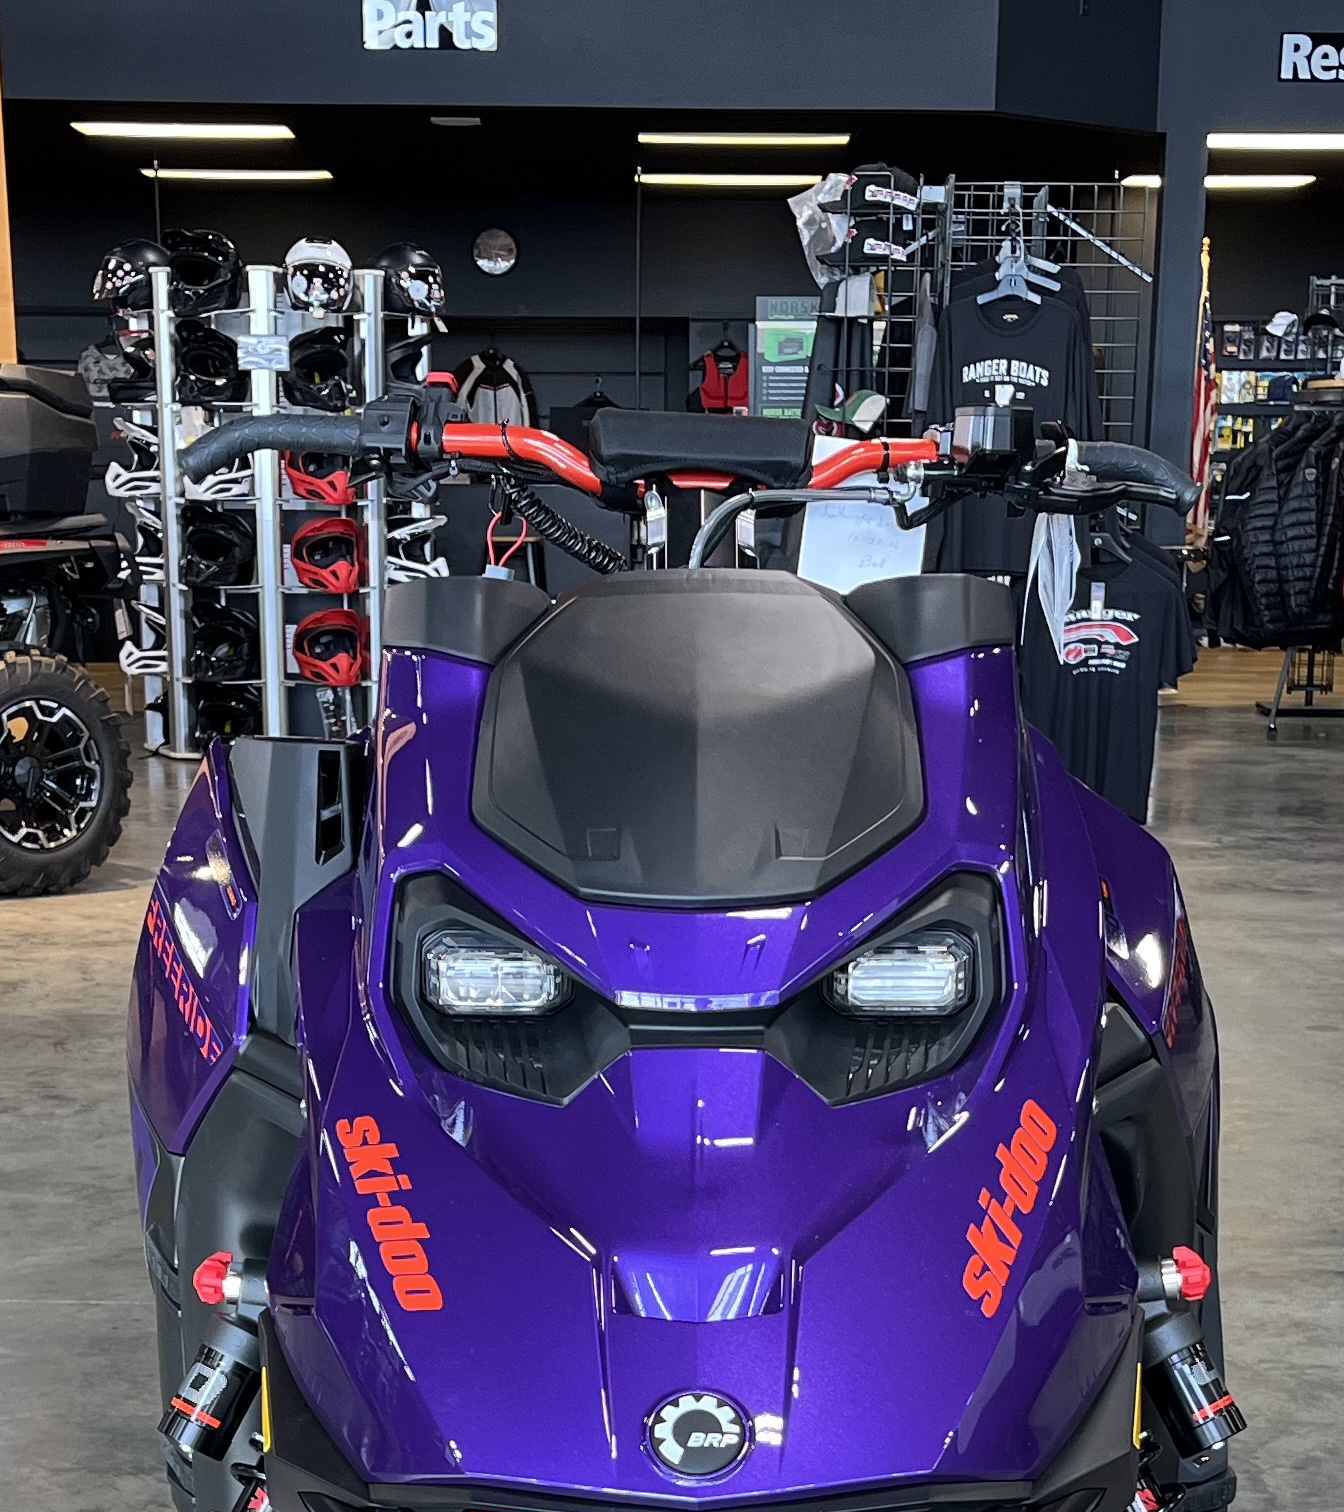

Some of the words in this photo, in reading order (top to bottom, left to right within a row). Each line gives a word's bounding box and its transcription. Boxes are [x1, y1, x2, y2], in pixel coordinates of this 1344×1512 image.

[362, 0, 496, 49] Parts
[962, 358, 1009, 384] RANGER
[1010, 360, 1050, 387] BOATS
[335, 1115, 444, 1312] ski-doo
[962, 1098, 1058, 1319] ski-doo
[686, 1432, 740, 1448] BRP
